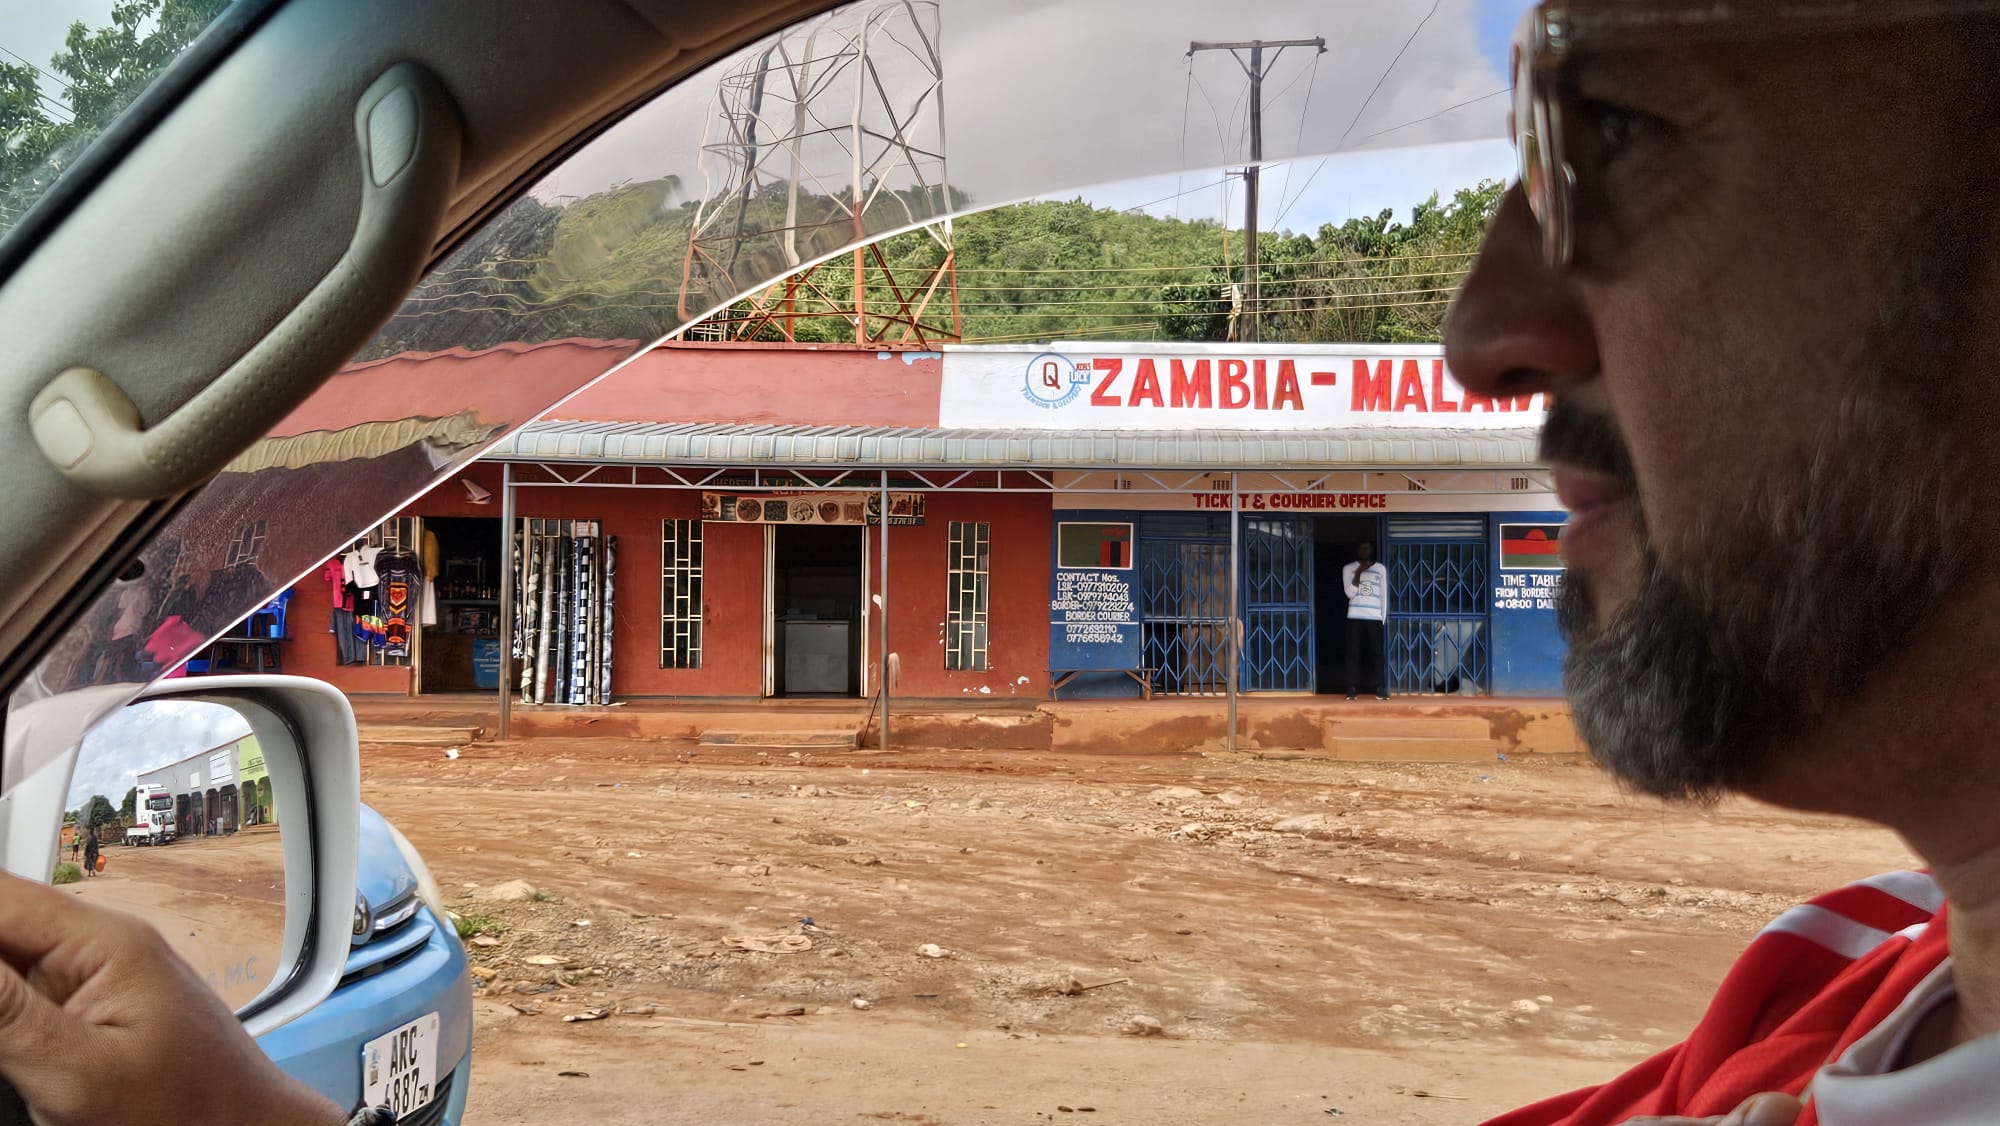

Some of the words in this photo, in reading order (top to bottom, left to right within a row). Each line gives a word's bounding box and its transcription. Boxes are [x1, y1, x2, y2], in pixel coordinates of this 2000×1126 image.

[1351, 359, 1553, 412] MAL
[1193, 493, 1249, 509] TICKT
[1252, 493, 1266, 510] &
[1269, 493, 1337, 509] COURIER
[1338, 493, 1386, 509] OFFICE
[1056, 572, 1100, 582] CONTACT
[1500, 574, 1526, 587] TIME
[1529, 574, 1563, 588] TABLE
[1495, 587, 1518, 598] FROM
[1505, 599, 1533, 609] 08:00
[1065, 611, 1096, 621] BORDER
[389, 1025, 418, 1078] ARC
